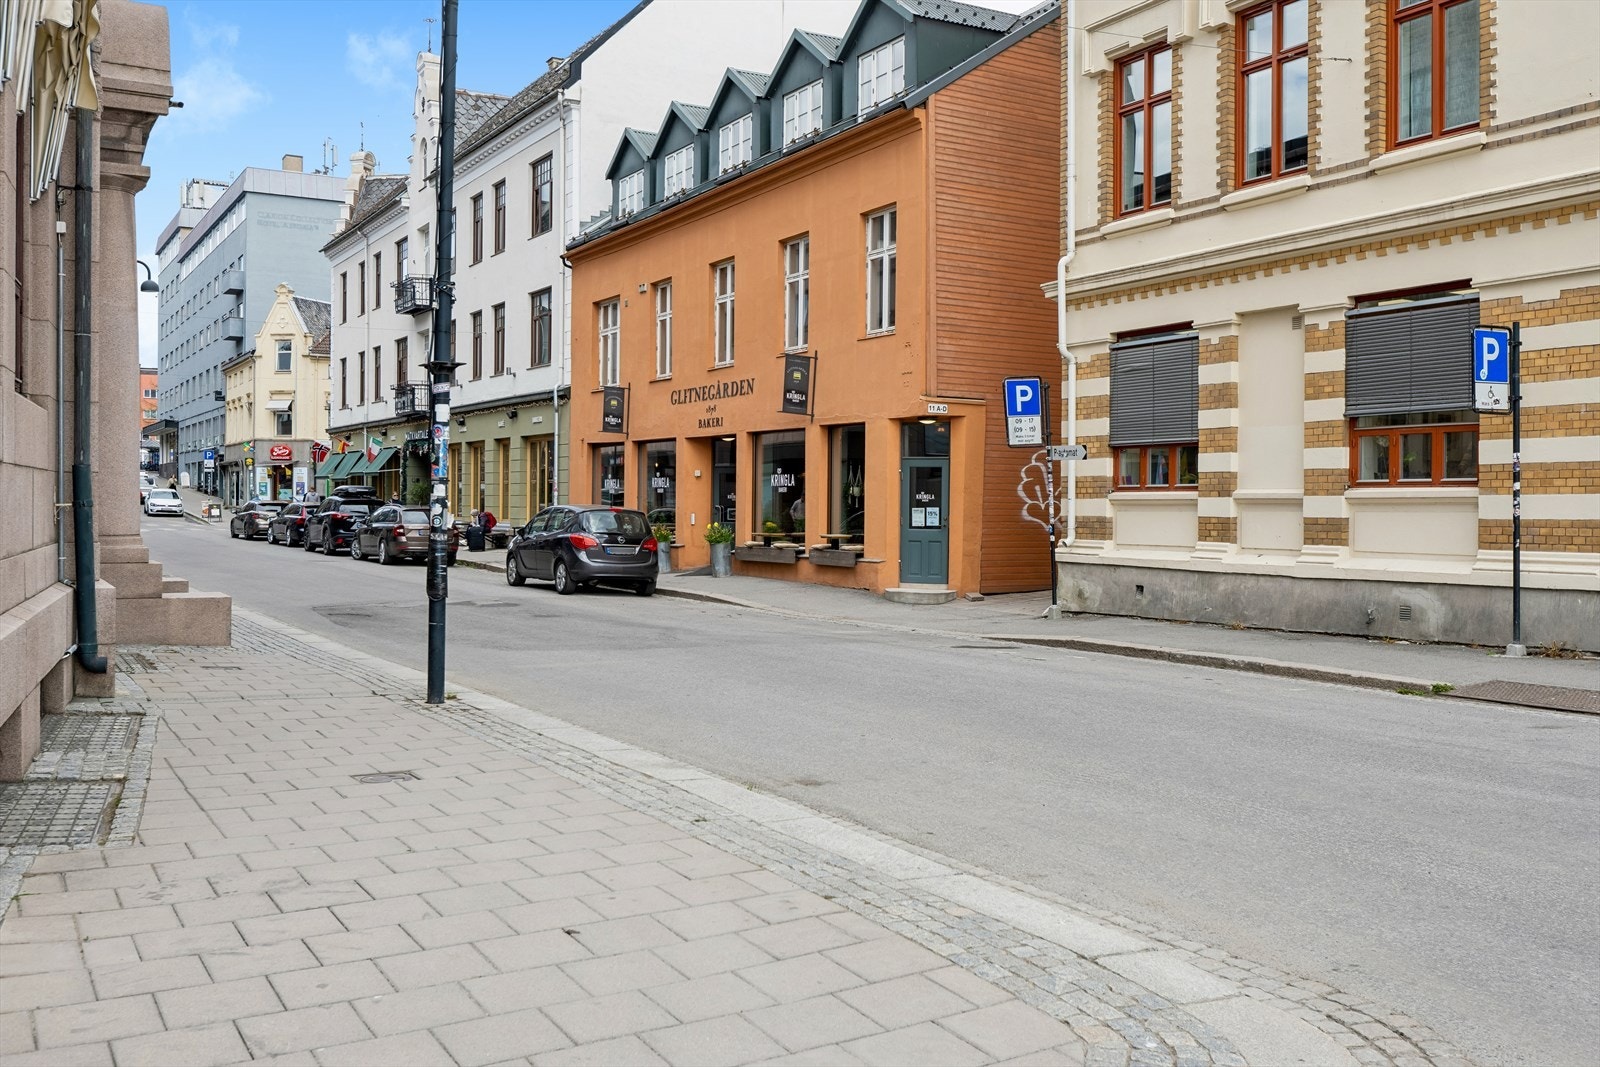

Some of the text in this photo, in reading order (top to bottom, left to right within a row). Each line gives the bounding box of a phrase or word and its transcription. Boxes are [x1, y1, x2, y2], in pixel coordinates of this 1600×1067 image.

[1482, 337, 1500, 380] P
[670, 378, 755, 406] GLITNEGÅRDEN
[786, 392, 806, 401] KRINGLA
[1016, 385, 1033, 412] P
[698, 417, 724, 429] BAKERI
[405, 430, 428, 440] MATKVARTALE
[651, 477, 670, 488] KRINGLA
[771, 474, 795, 487] KRINGLA
